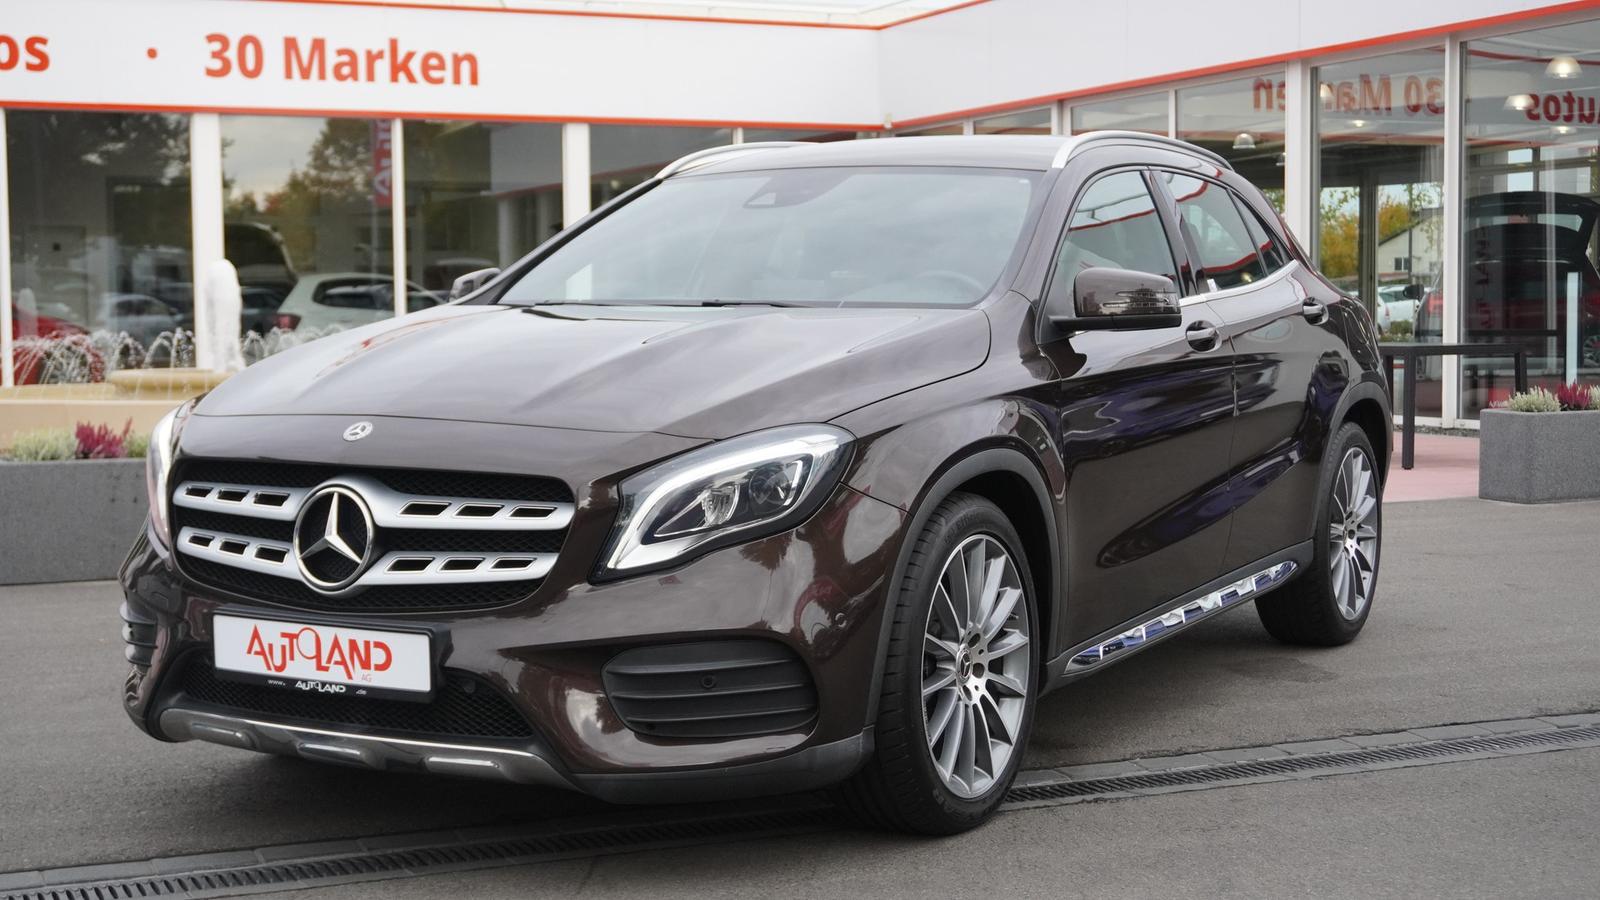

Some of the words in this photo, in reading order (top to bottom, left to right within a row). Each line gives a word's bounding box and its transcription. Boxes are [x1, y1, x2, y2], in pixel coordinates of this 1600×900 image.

[0, 34, 50, 73] os
[205, 33, 264, 79] 30
[283, 36, 479, 86] Marken
[246, 625, 393, 680] AUTOLAND
[295, 680, 346, 694] AUTOLAND
